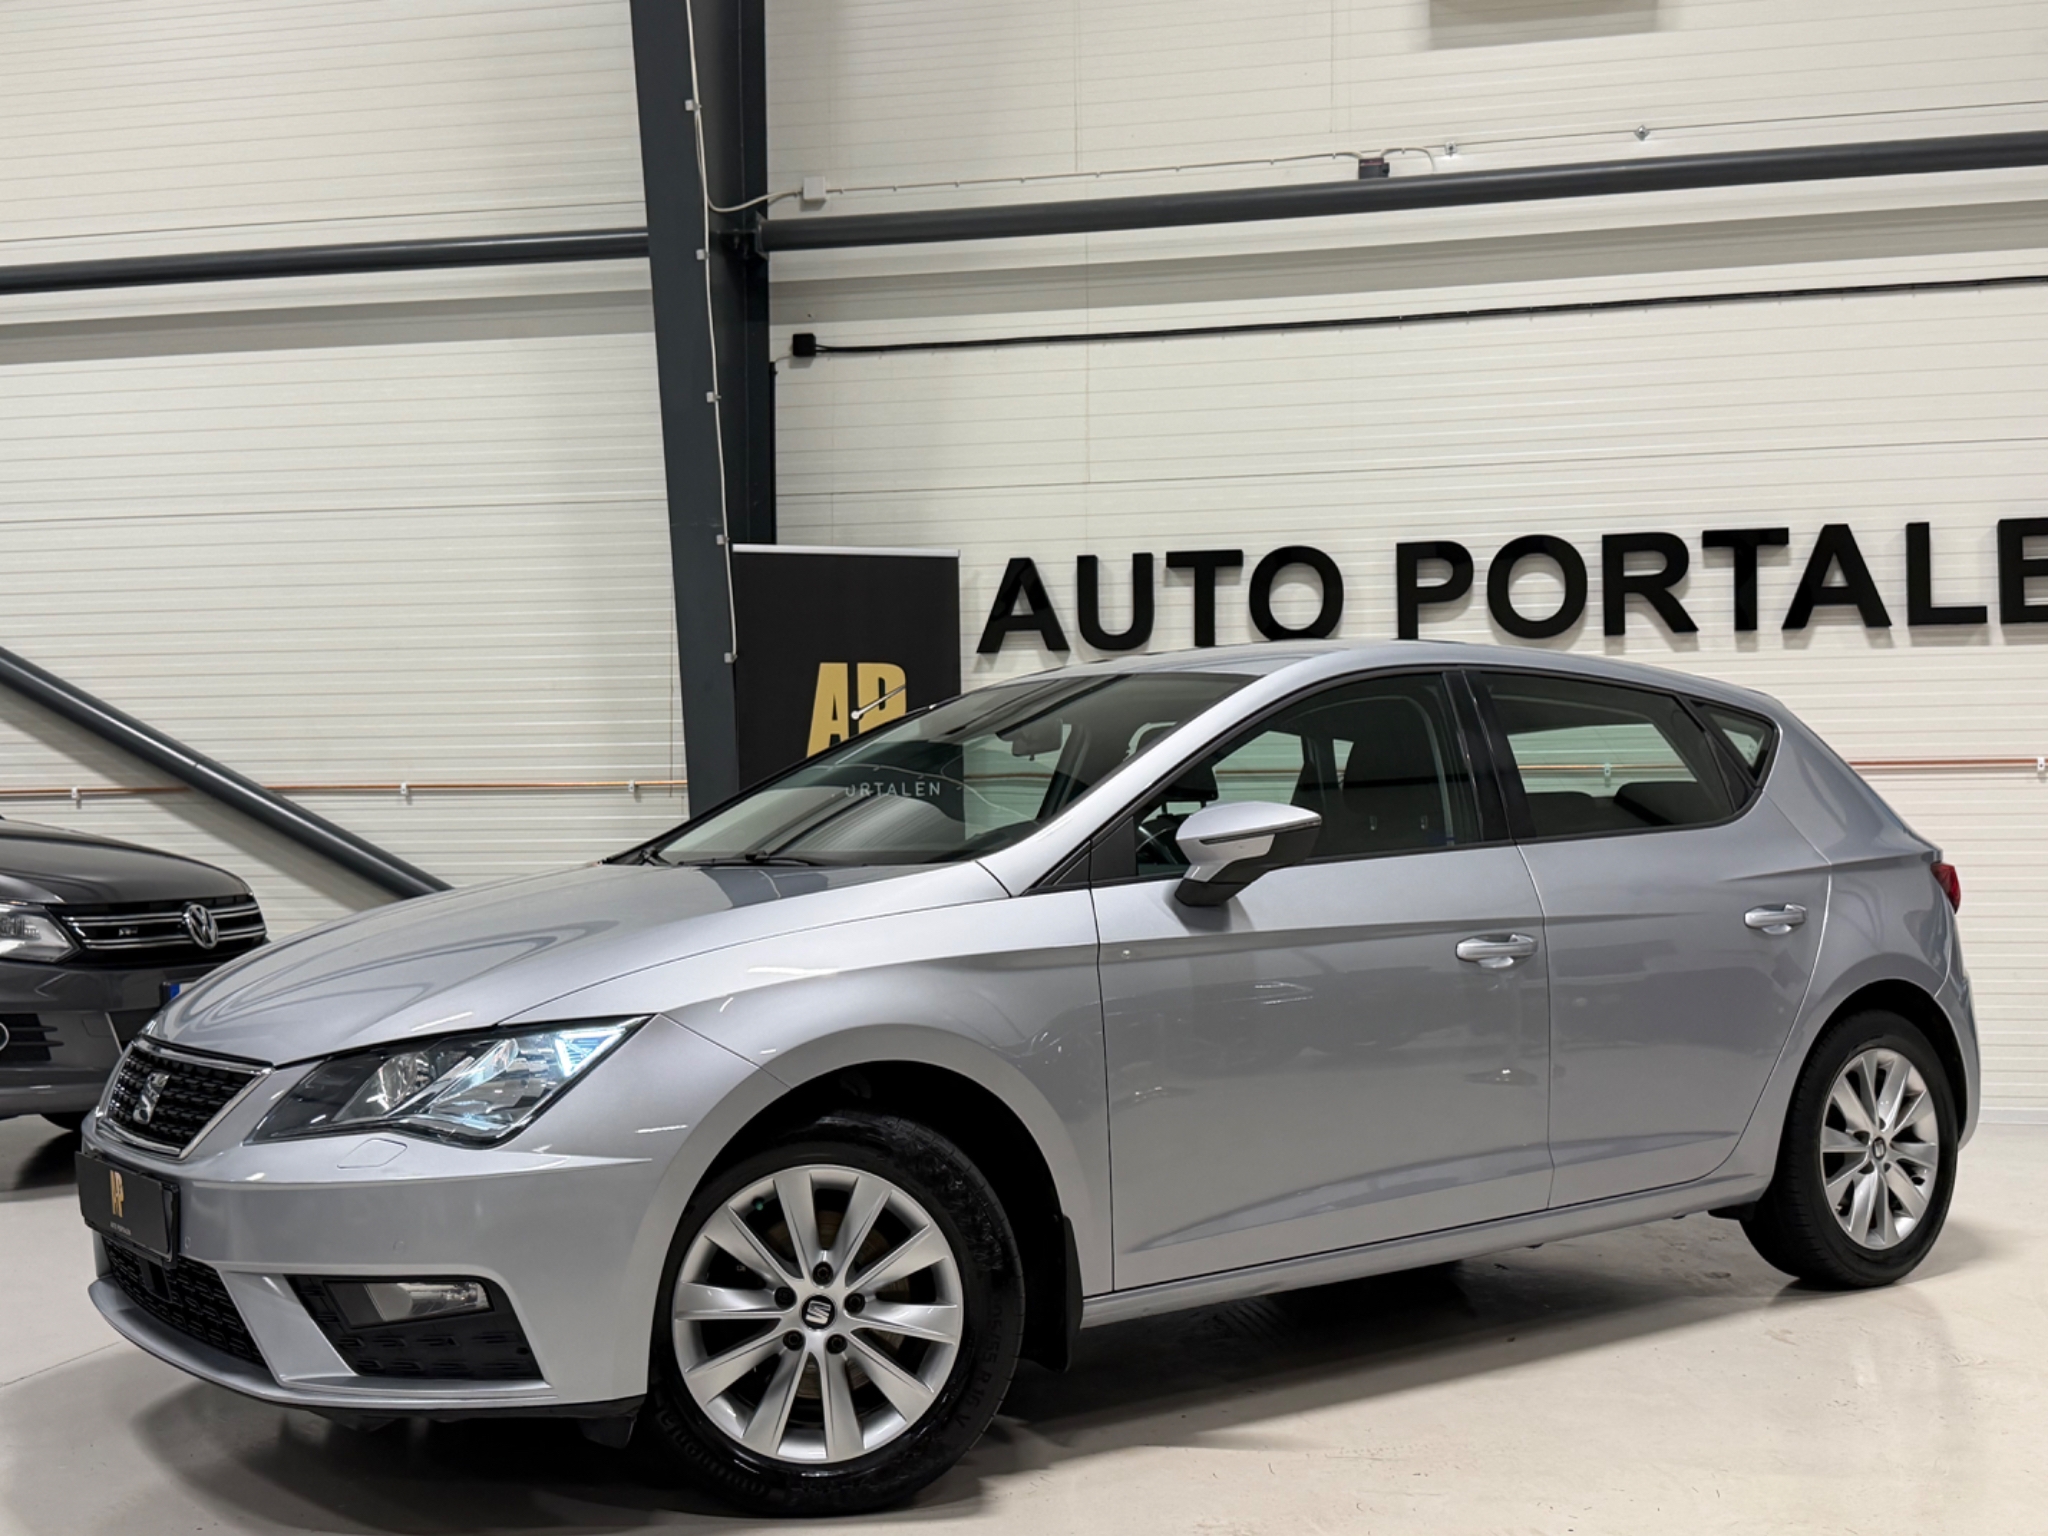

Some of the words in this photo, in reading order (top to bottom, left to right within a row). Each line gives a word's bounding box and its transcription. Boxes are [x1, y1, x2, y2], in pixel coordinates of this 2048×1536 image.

[976, 545, 1344, 654] AUTO
[1396, 517, 2048, 642] PORTALE
[831, 782, 940, 797] ORTALEN
